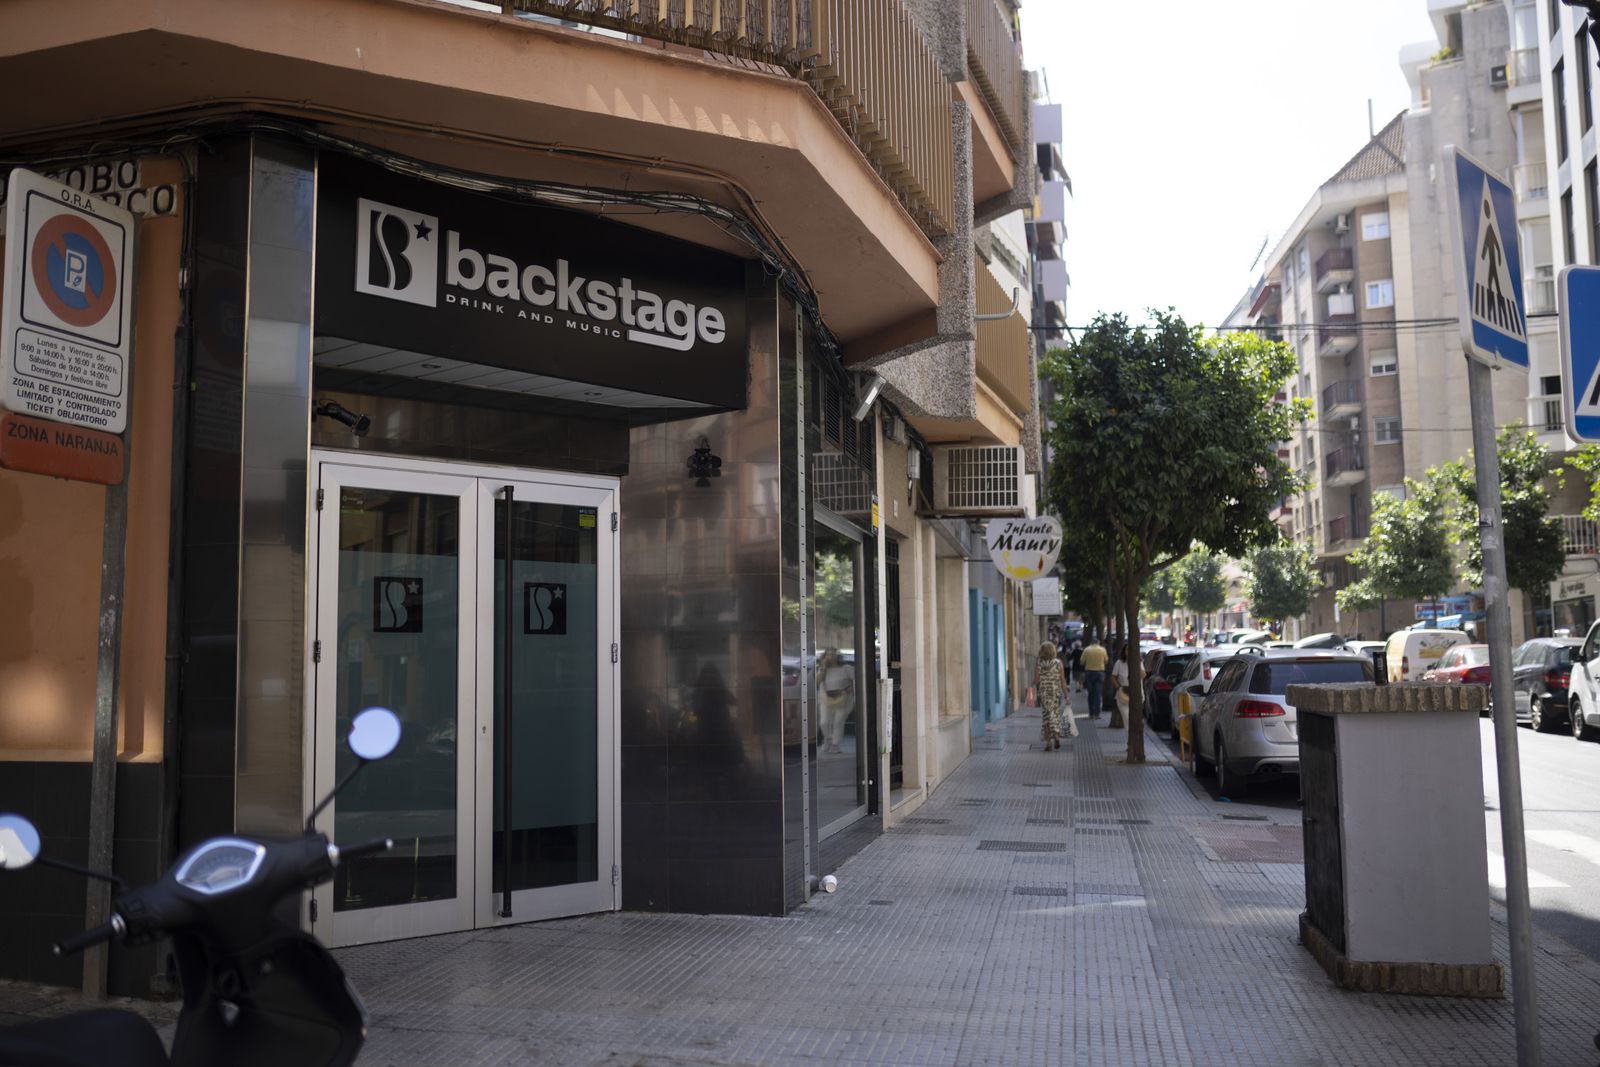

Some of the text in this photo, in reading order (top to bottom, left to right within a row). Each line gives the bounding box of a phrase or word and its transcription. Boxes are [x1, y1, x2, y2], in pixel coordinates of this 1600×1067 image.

[61, 189, 96, 212] O.R.A.
[446, 229, 726, 352] backstage
[445, 294, 621, 338] DRINK AND MUSIC
[36, 337, 58, 349] Lunes
[69, 345, 93, 359] Viernes
[28, 354, 57, 368] Sábados
[58, 361, 67, 370] de
[31, 364, 63, 378] Domingos
[70, 374, 94, 386] festivos
[12, 377, 122, 409] ZONA DE ESTACIONAMIENTO
[16, 389, 117, 418] LIMITADO Y CONTROLADO
[26, 402, 108, 426] TICKET OBLIGATORIO
[7, 422, 119, 457] ZONA NARANJA
[990, 534, 1061, 555] Maury
